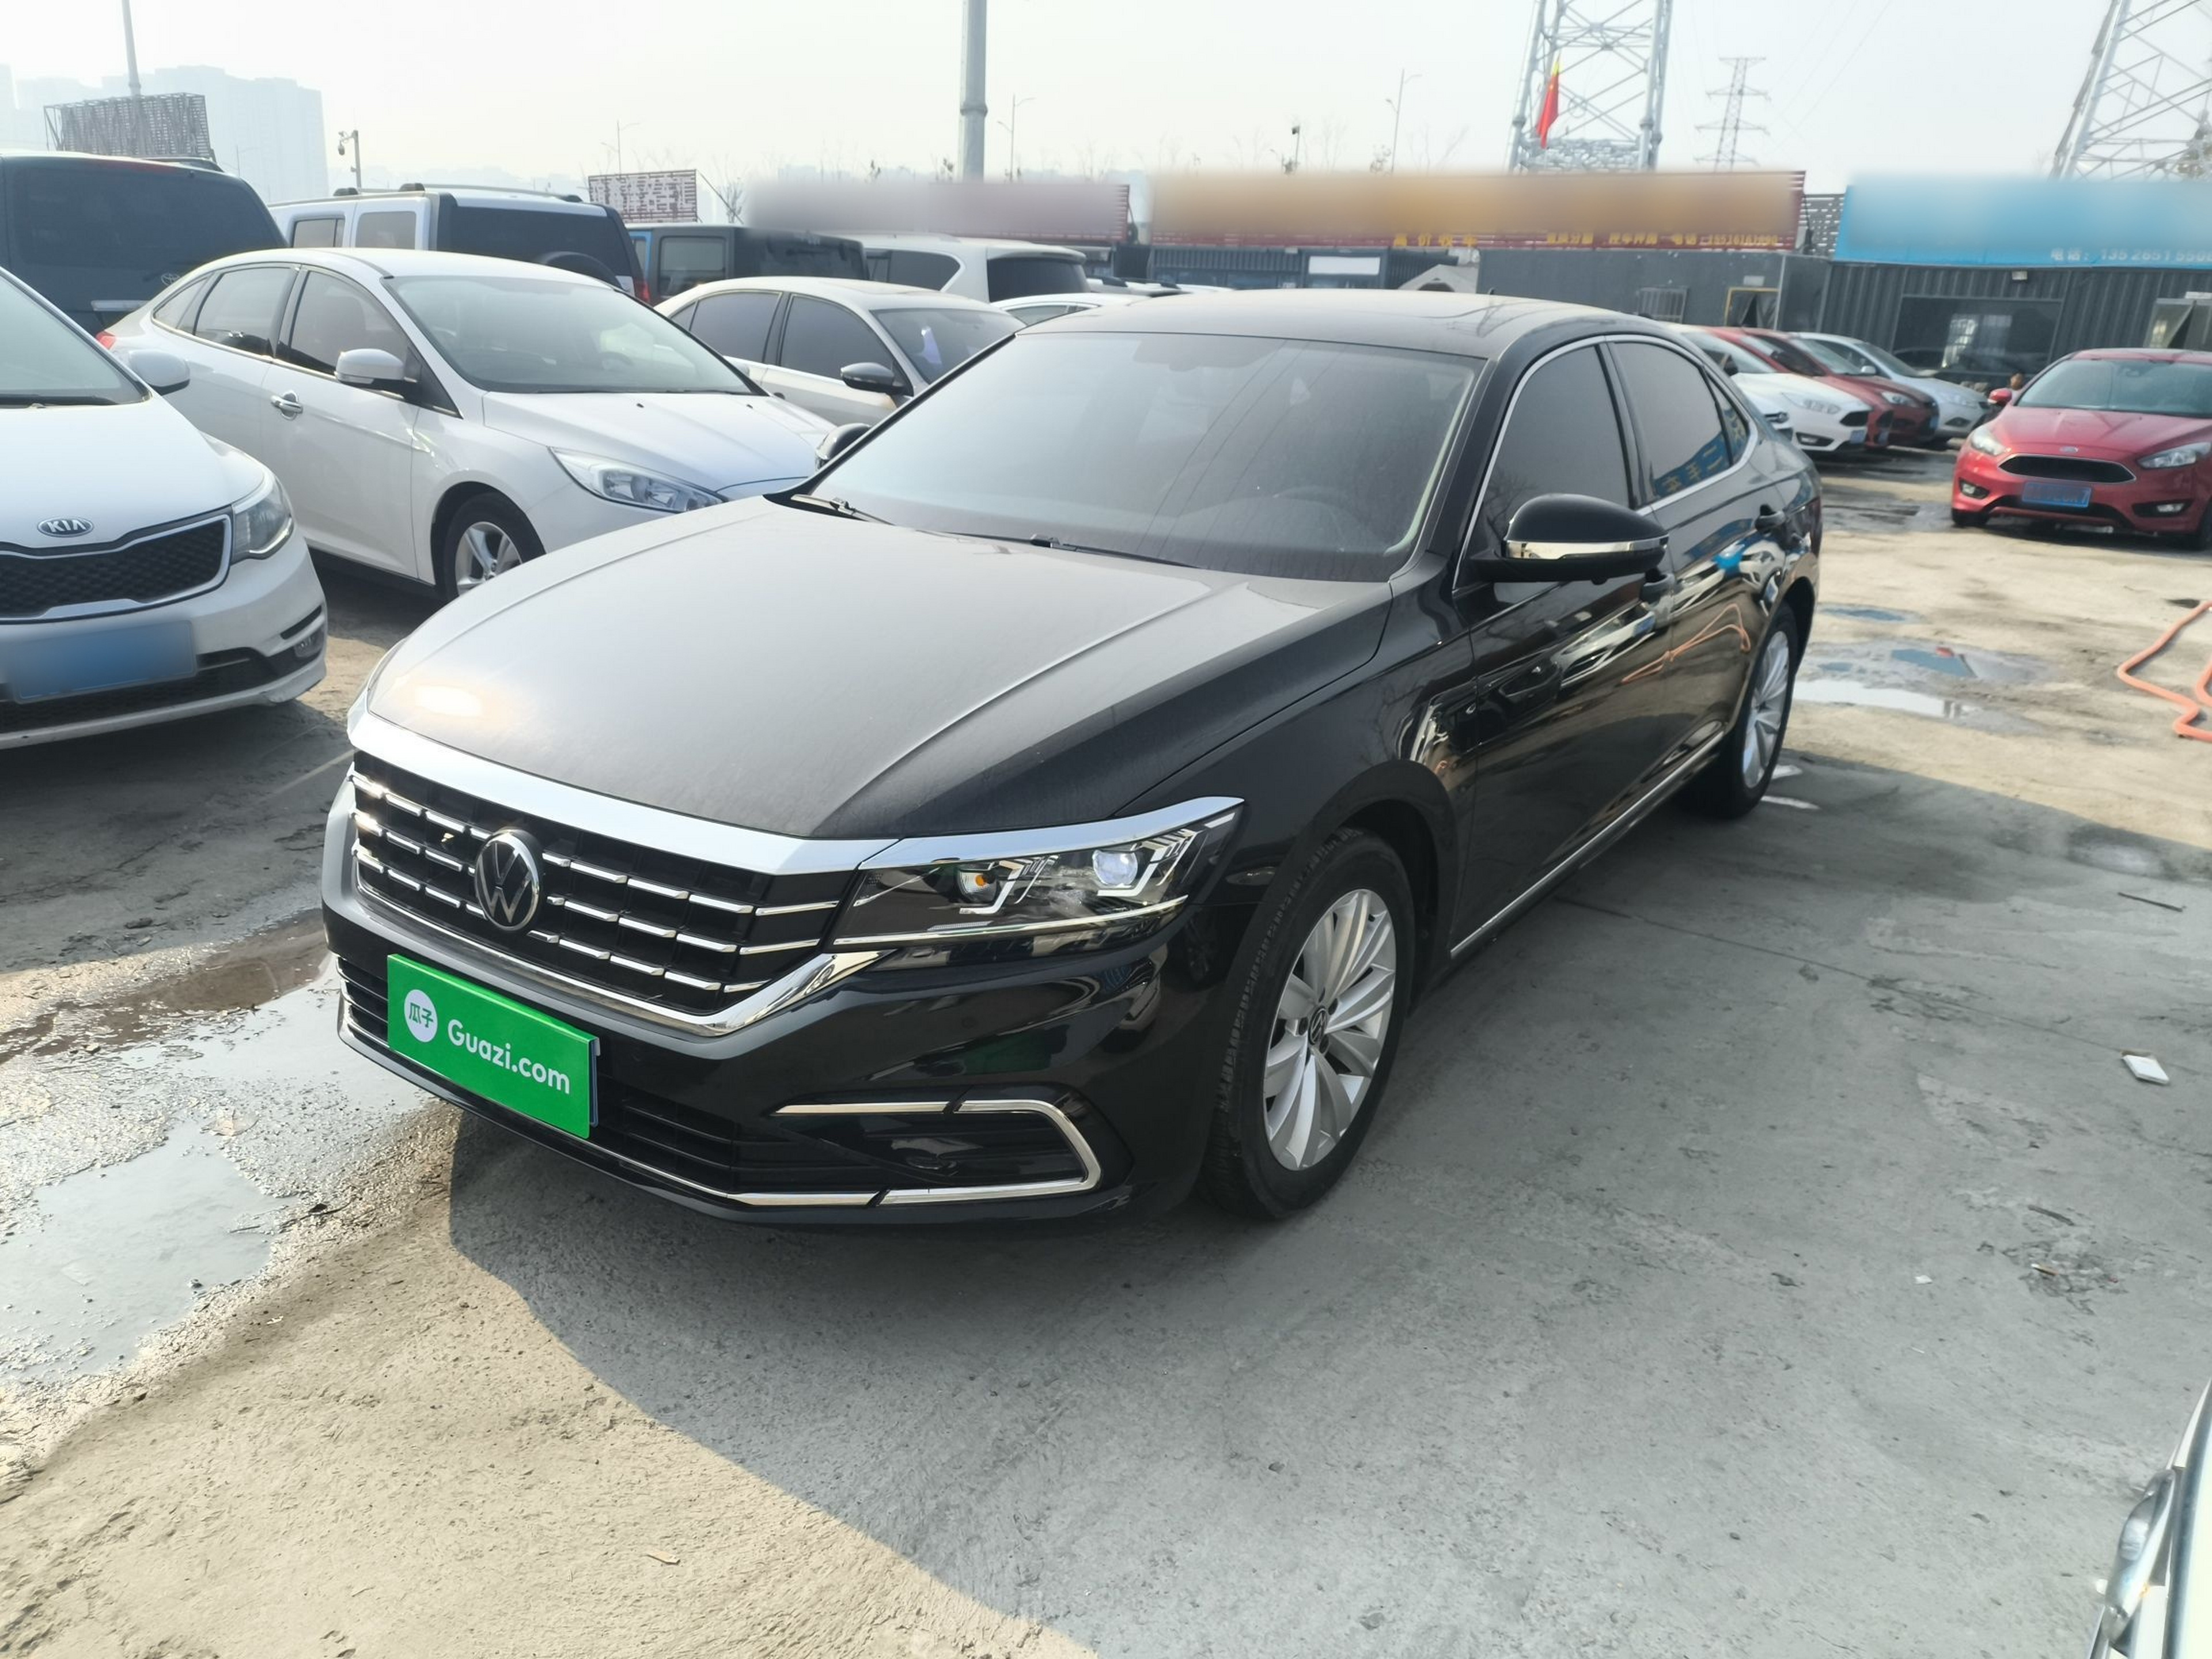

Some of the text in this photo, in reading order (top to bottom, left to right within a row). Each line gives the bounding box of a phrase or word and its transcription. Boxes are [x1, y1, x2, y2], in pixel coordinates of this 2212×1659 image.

[47, 519, 87, 532] KIA
[408, 1002, 570, 1095] 瓜子 Guazi.com
